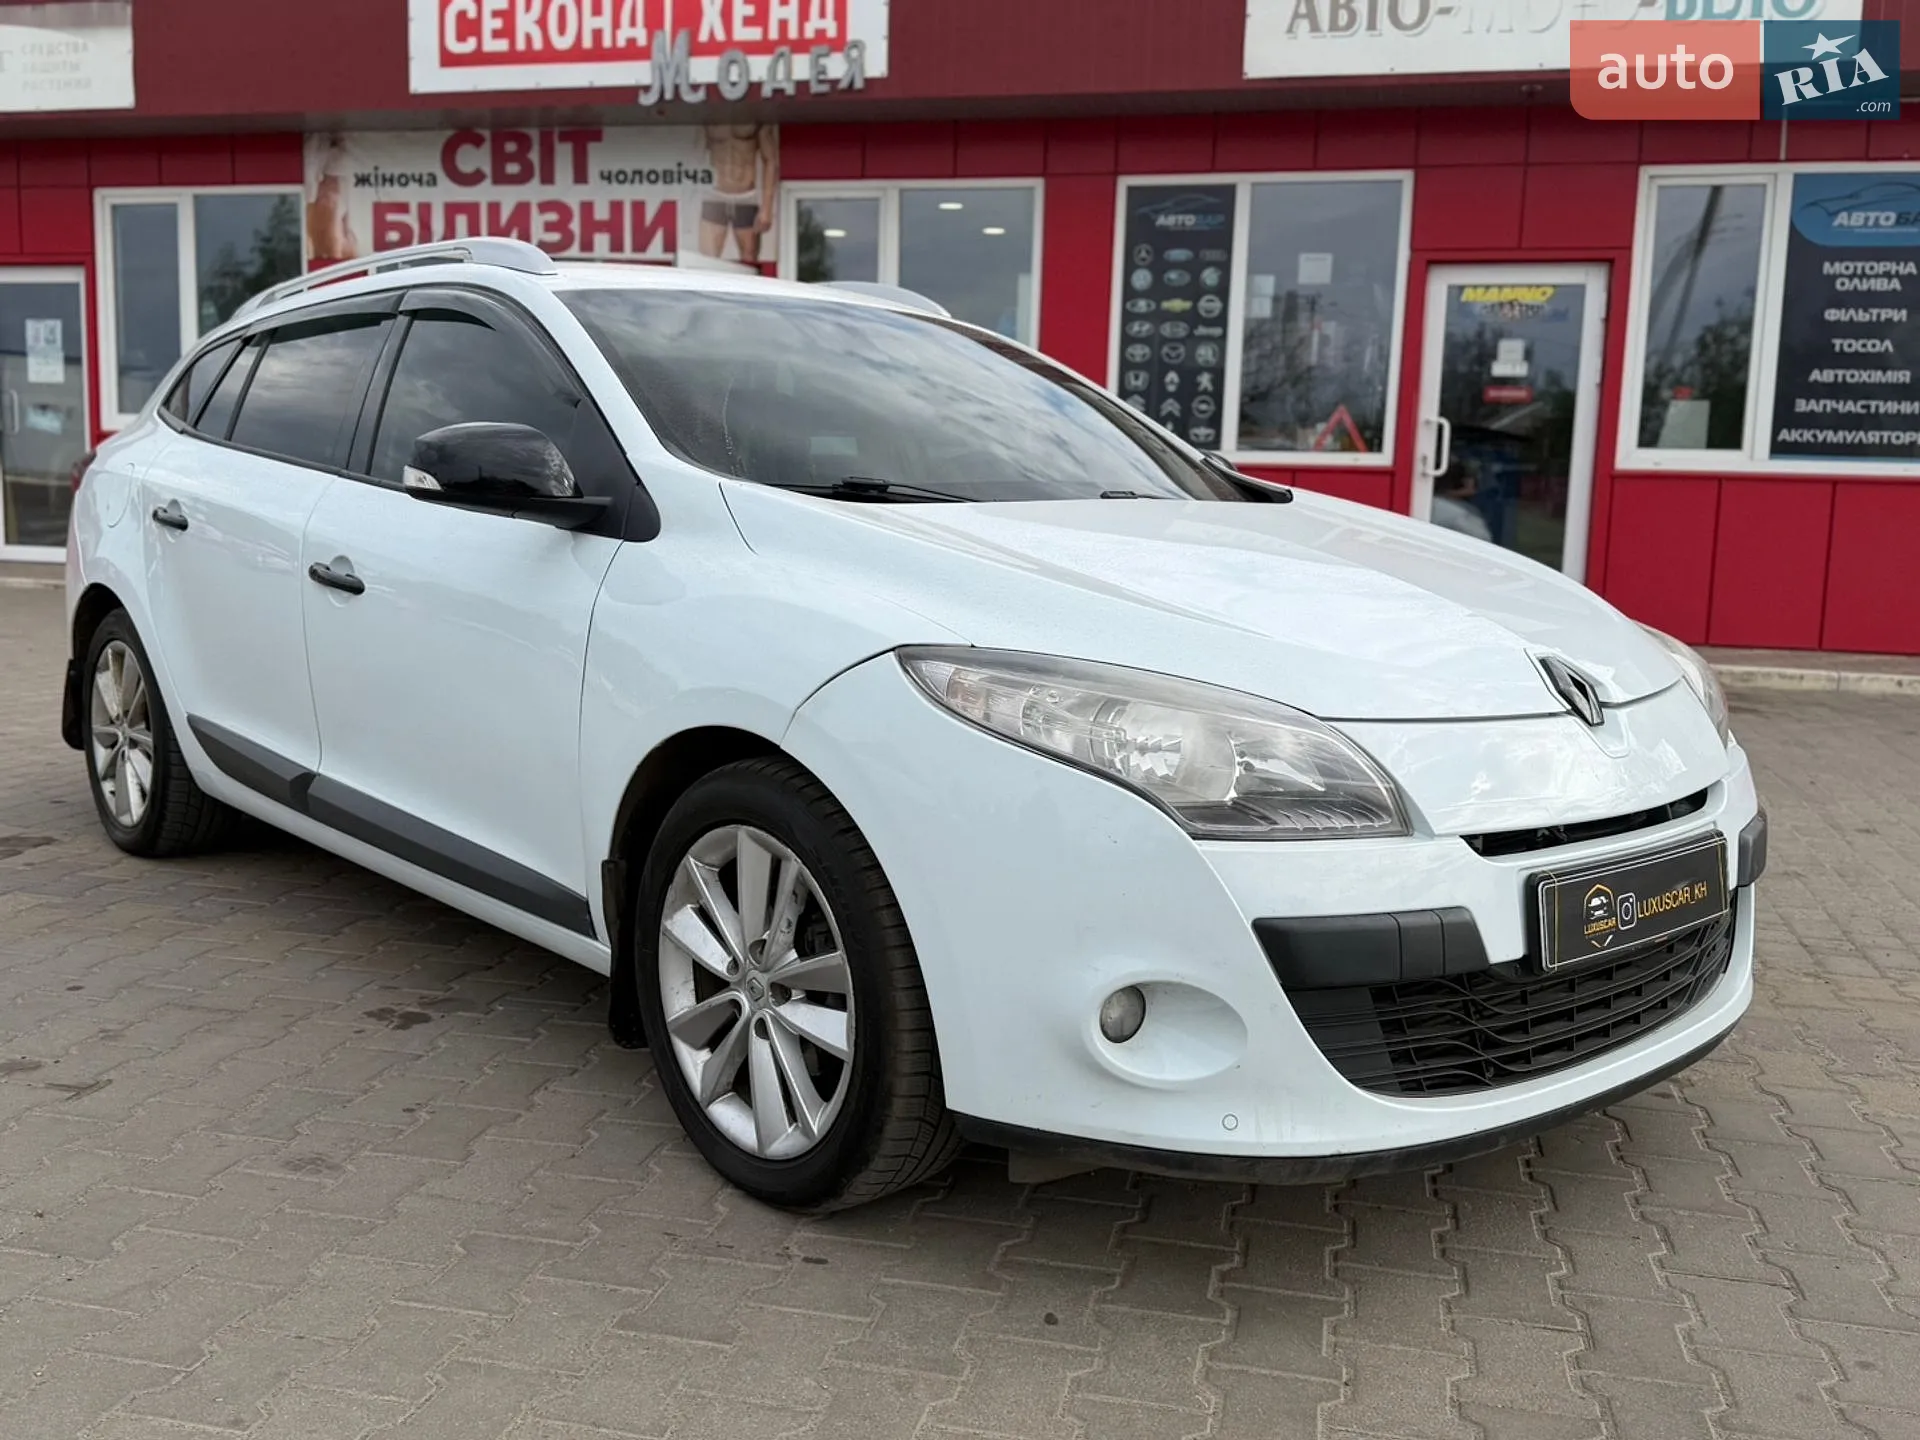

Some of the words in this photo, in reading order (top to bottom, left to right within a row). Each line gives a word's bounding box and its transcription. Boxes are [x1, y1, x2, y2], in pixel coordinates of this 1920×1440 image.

[444, 0, 647, 54] СЕКОНД
[698, 0, 838, 43] ХЕНД
[441, 128, 603, 187] СВІТ
[354, 166, 438, 188] жіноча
[599, 162, 713, 185] чоловіча
[372, 199, 678, 255] БІЛИЗНИ
[1822, 260, 1918, 276] МОТОРНА
[1834, 277, 1902, 292] ОЛИВА
[1824, 307, 1908, 323] ФІЛЬТРИ
[1831, 338, 1894, 353] ТОСОЛ
[1808, 368, 1911, 384] АВТОХІМІЯ
[1794, 397, 1920, 415] ЗАПЧАСТИНИ
[1637, 880, 1708, 919] LUXUSCAR_KH
[1583, 916, 1617, 937] LUXUSCAR
